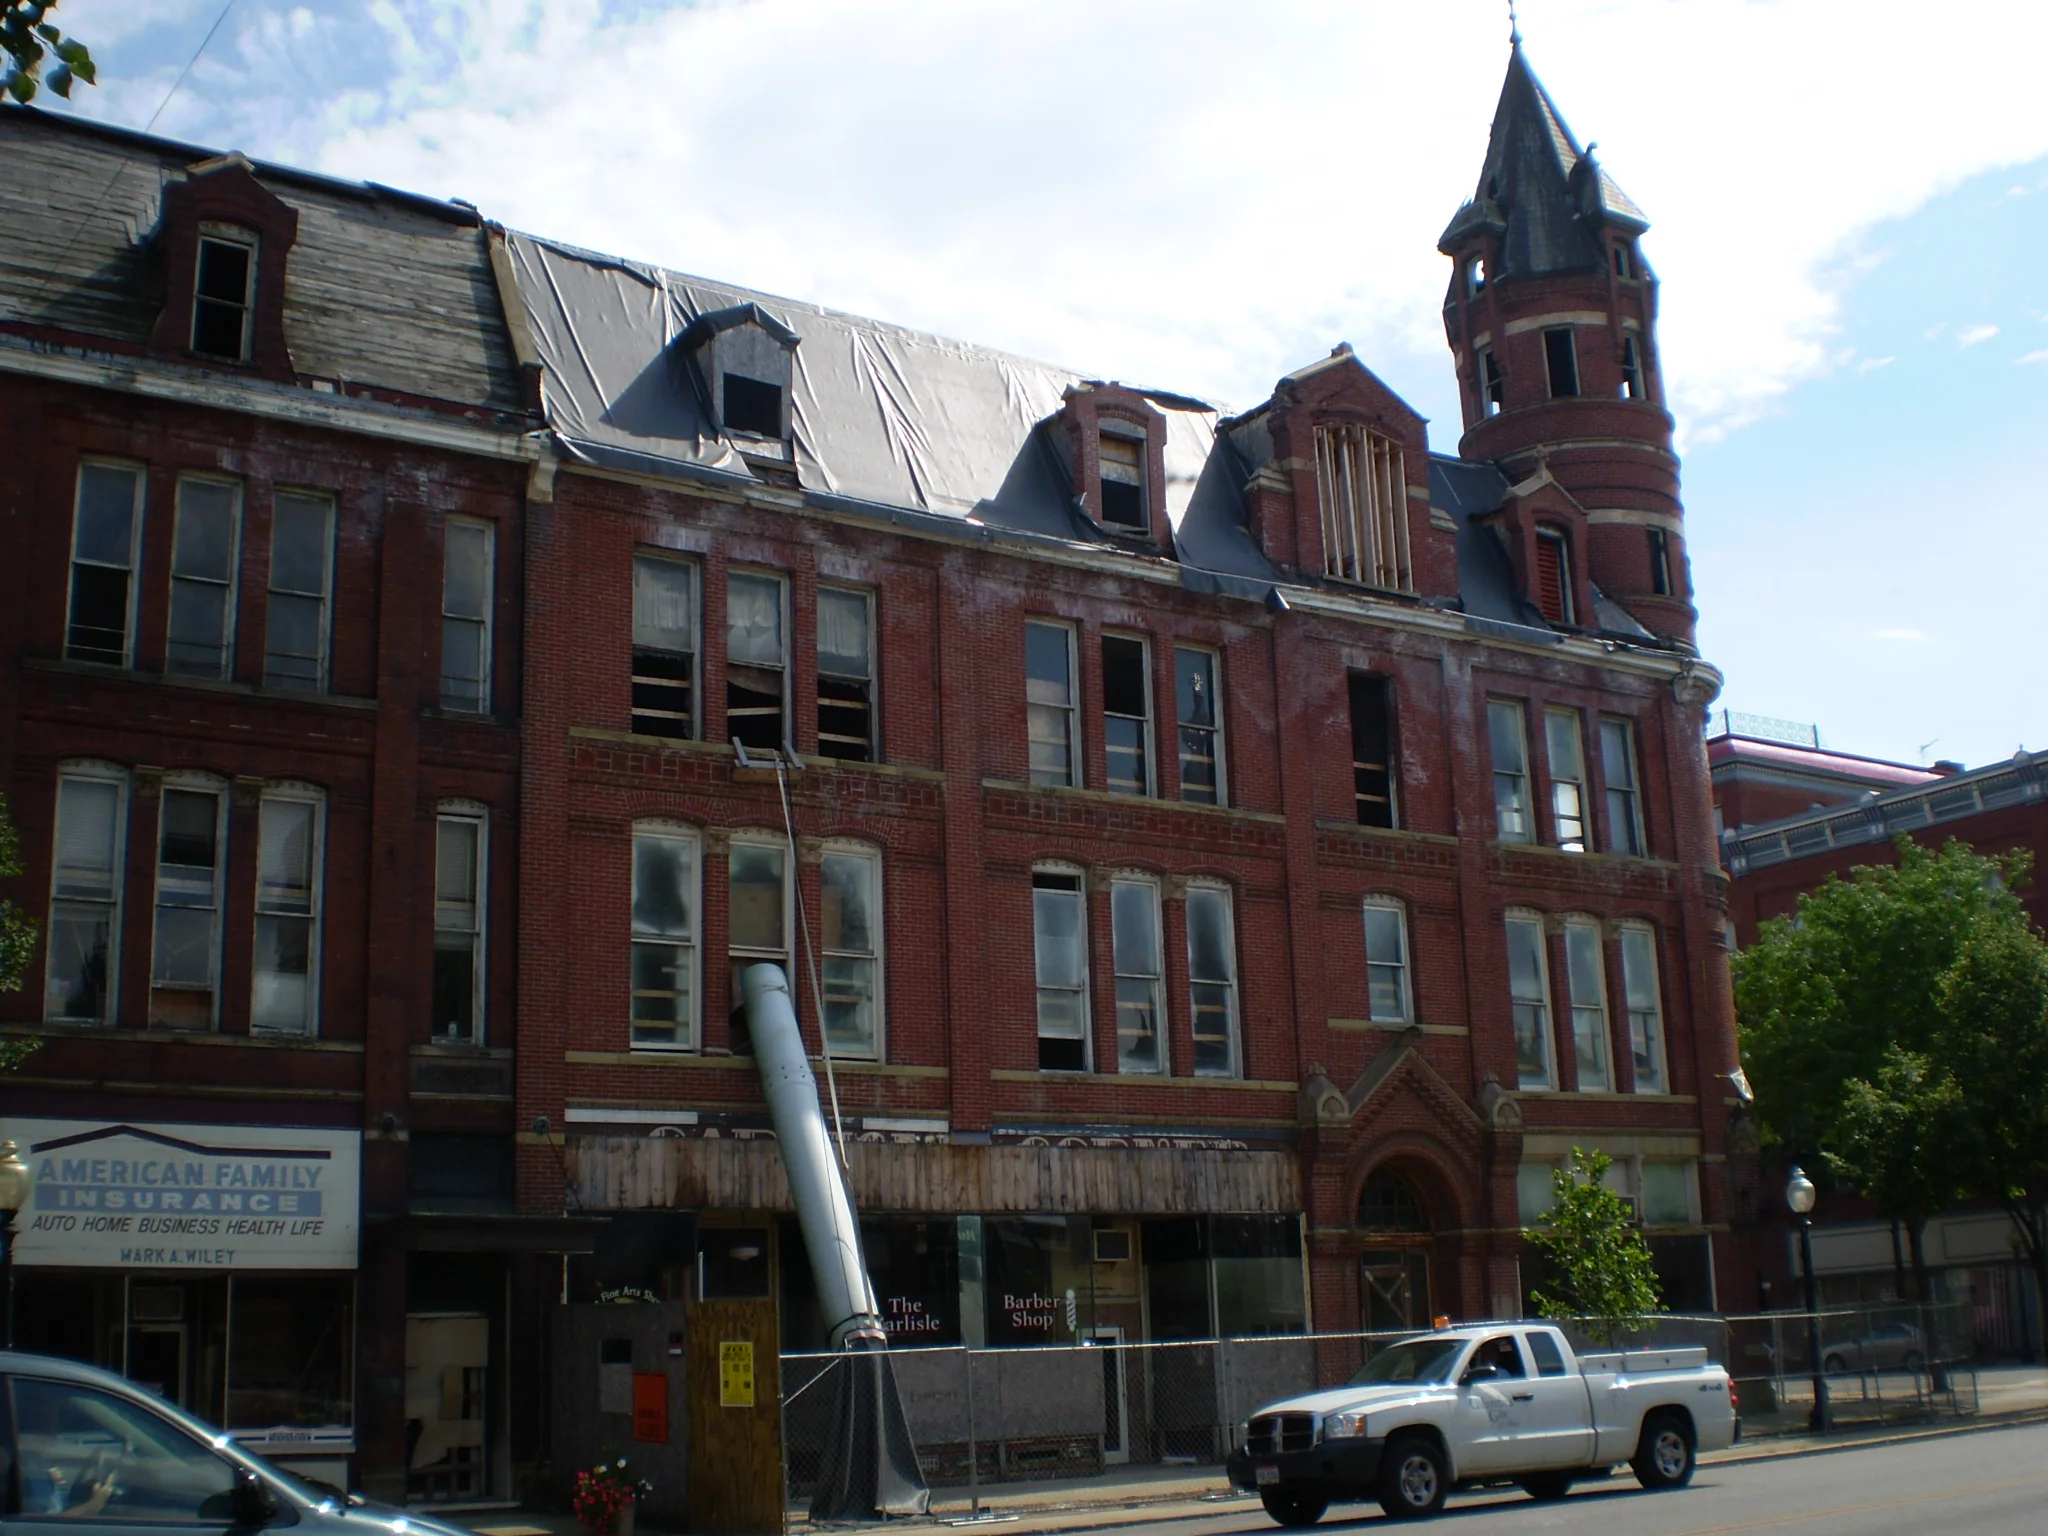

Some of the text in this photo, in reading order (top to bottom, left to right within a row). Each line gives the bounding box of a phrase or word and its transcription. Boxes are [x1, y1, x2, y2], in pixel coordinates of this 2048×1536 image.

[37, 1158, 323, 1189] AMERICAN FAMILY
[58, 1189, 300, 1212] INSURANCE
[31, 1216, 324, 1236] AUTO HOME BUSINESS HEALTH LIFE
[120, 1248, 165, 1264] MARK
[186, 1249, 235, 1264] WILEY
[600, 1290, 620, 1302] Fine
[623, 1286, 641, 1297] Arts
[1003, 1292, 1061, 1310] Barber
[889, 1297, 922, 1313] The
[885, 1314, 940, 1331] arlisle
[1012, 1311, 1054, 1330] Shop
